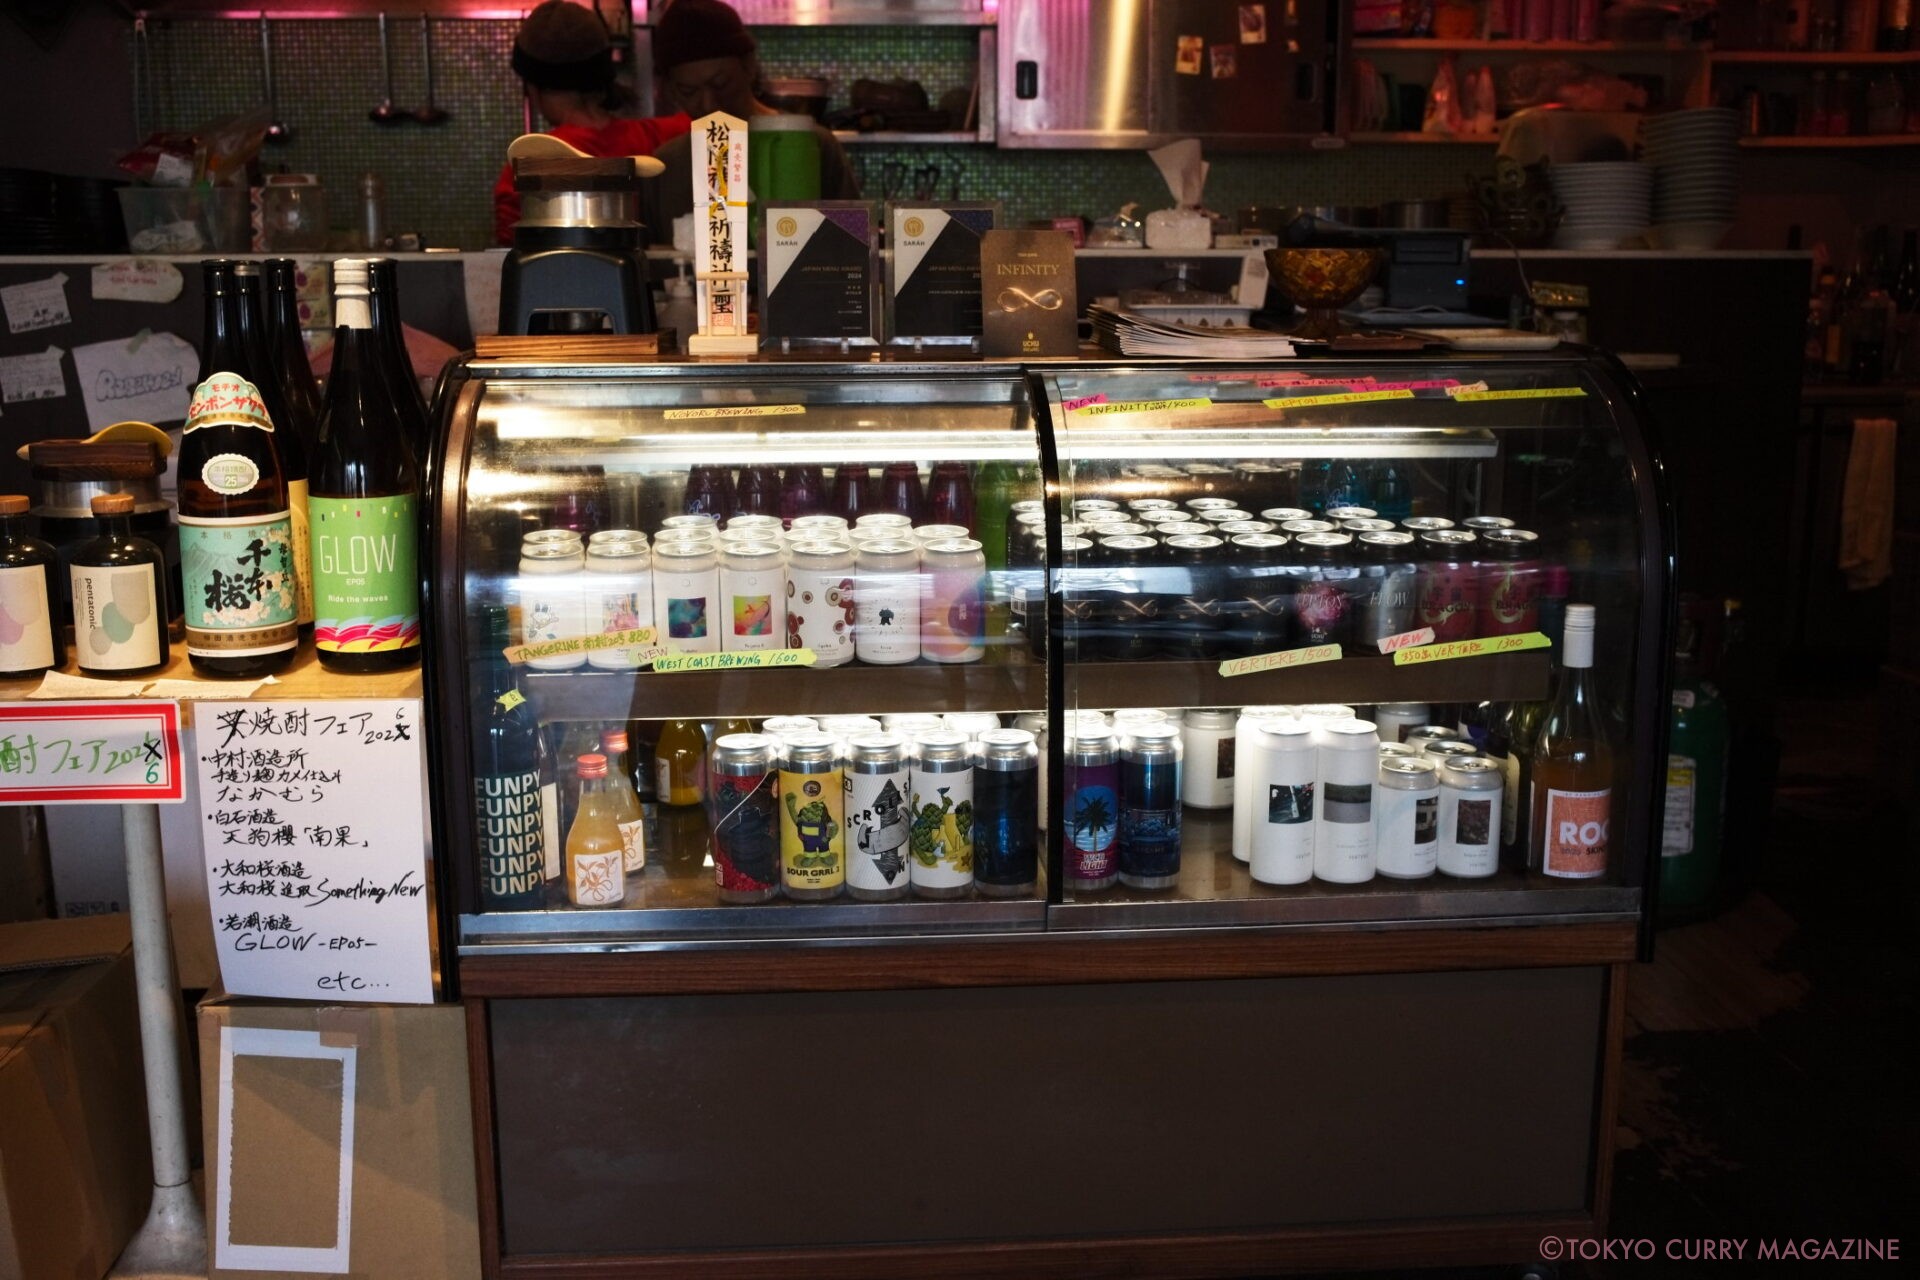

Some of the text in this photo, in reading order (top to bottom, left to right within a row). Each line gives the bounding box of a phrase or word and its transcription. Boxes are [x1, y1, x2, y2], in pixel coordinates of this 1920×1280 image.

[997, 264, 1060, 275] INFINITY
[1068, 395, 1101, 410] NEW
[1087, 402, 1149, 414] INFINITY
[225, 476, 237, 487] 25
[319, 533, 397, 574] GLOW
[84, 577, 96, 631] pentatonic
[328, 594, 388, 603] Ride the waves
[1370, 591, 1409, 607] FLOW
[629, 630, 651, 643] 880
[1385, 632, 1426, 652] NEW
[637, 646, 669, 663] NEW
[656, 655, 683, 670] WEST
[686, 654, 715, 669] COAST
[718, 651, 761, 668] BREWING
[1228, 650, 1298, 674] VERTERE
[216, 785, 325, 803] なかむら
[787, 867, 809, 877] SOUR
[304, 878, 389, 908] Something
[389, 870, 425, 899] New
[234, 932, 318, 952] GLOW
